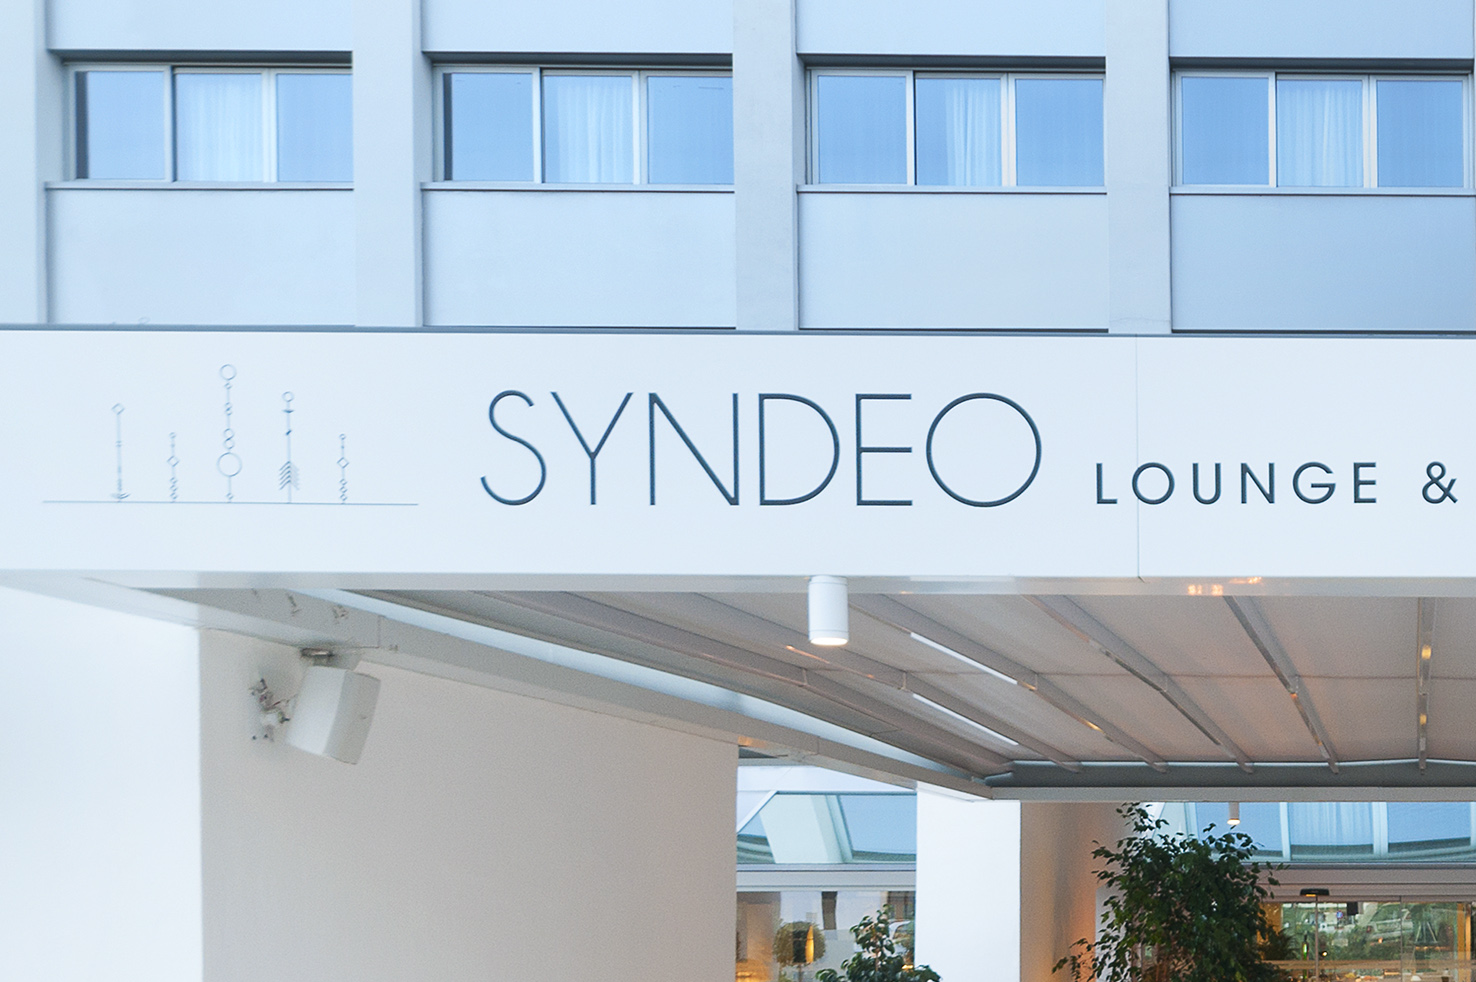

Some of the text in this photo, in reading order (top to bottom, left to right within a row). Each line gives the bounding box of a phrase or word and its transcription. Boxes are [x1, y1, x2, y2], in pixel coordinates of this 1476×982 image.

[481, 389, 1042, 508] SYNDEO
[1096, 461, 1377, 506] LOUNGE
[1421, 461, 1458, 505] &
